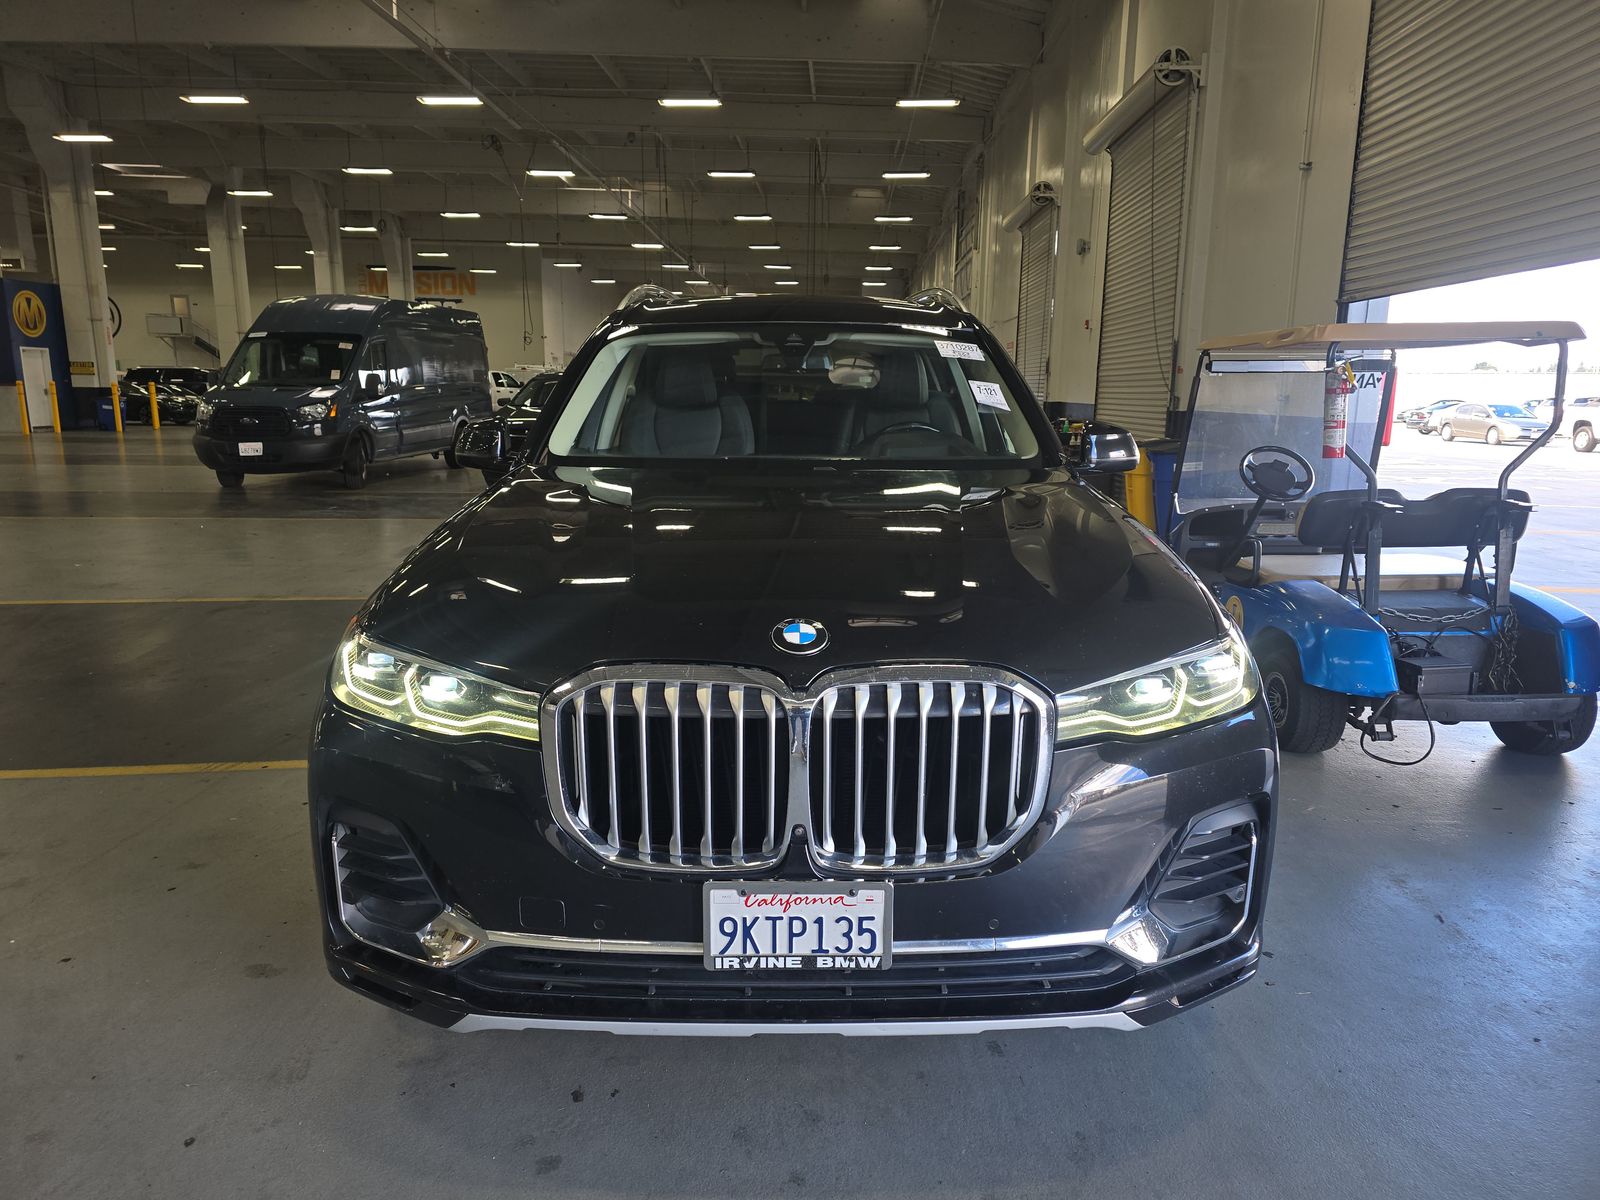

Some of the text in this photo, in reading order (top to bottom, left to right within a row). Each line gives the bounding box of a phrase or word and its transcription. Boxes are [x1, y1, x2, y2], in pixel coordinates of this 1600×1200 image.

[367, 272, 477, 295] MSION
[744, 893, 857, 913] California
[718, 915, 877, 955] 9KTP135
[715, 957, 882, 969] IRVINE BMW
